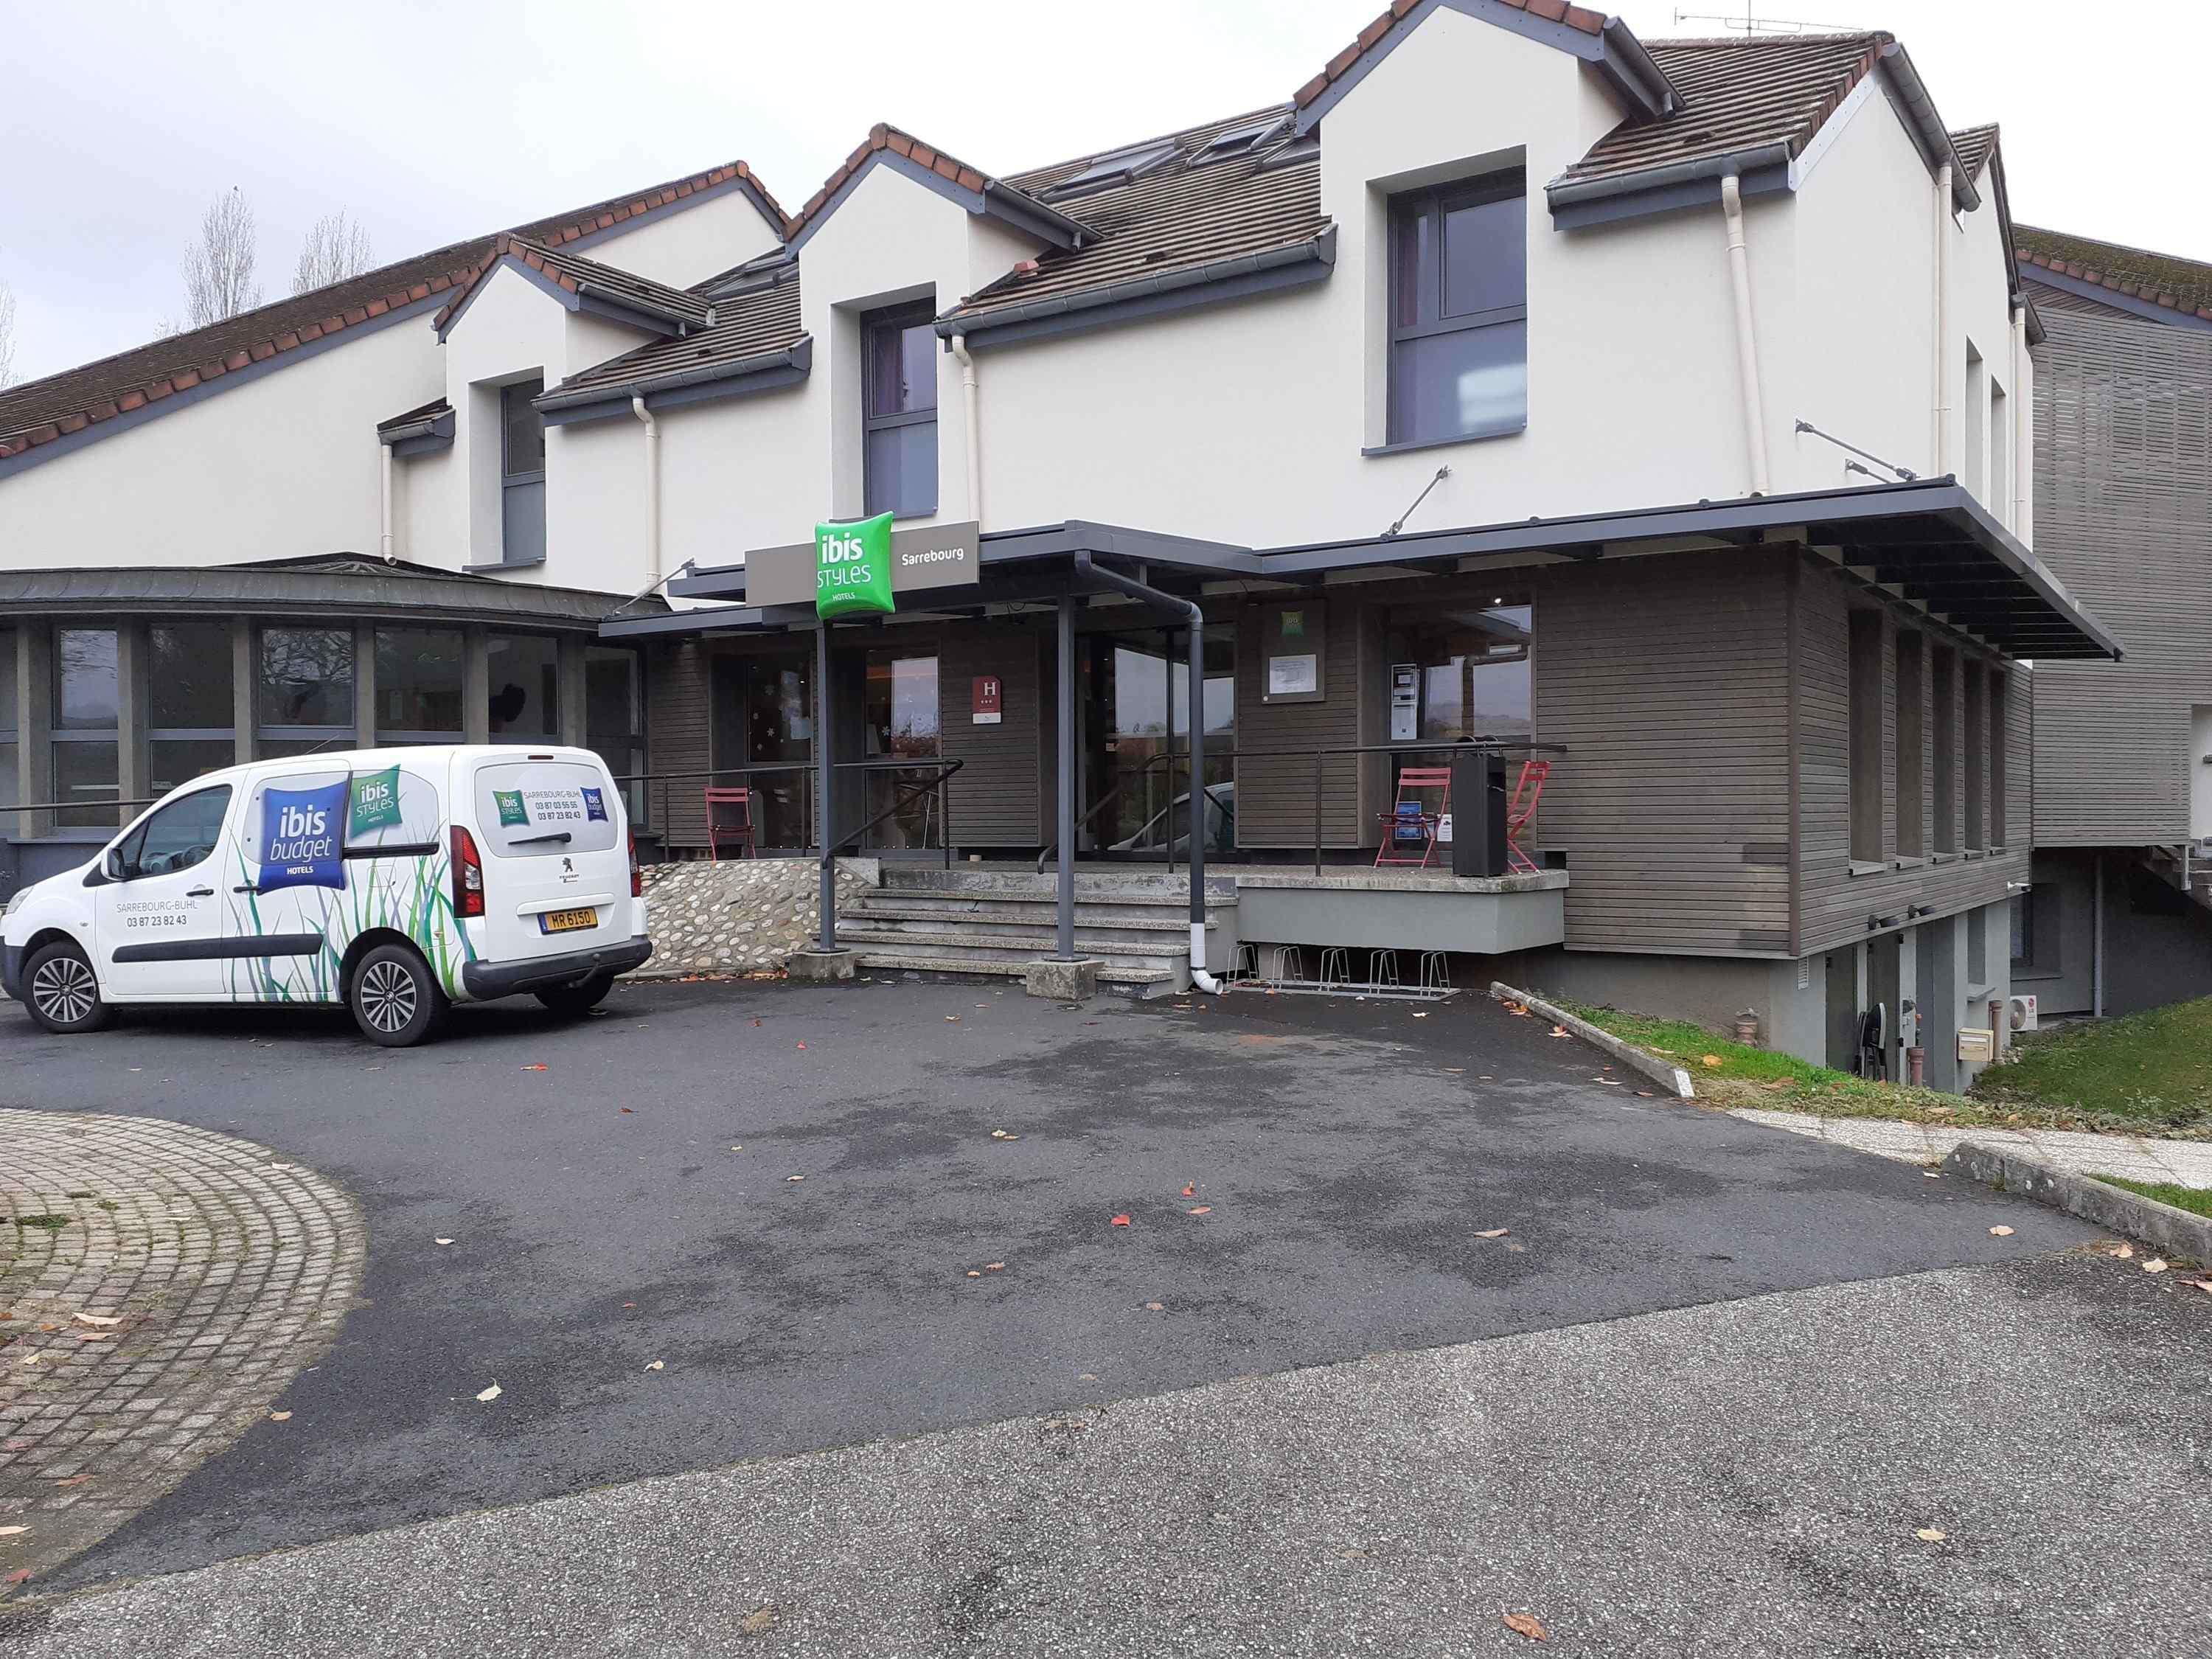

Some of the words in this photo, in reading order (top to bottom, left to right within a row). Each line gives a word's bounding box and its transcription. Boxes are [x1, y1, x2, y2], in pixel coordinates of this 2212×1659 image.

[822, 532, 863, 564] ibis
[902, 548, 964, 566] Sarrebourg
[832, 591, 856, 602] HOTELS
[984, 682, 996, 696] H
[361, 782, 389, 803] ibis
[501, 796, 519, 807] ibis
[535, 801, 544, 810] 03
[553, 801, 561, 810] 03
[280, 804, 326, 838] ibis
[538, 812, 546, 820] 03
[548, 812, 555, 820] 87
[556, 812, 565, 820] 23
[565, 811, 573, 819] 82
[270, 835, 333, 863] budget
[287, 866, 313, 875] HOTELS
[116, 899, 199, 913] SARREBOURG-BUHL
[127, 917, 137, 928] 03
[139, 917, 149, 927] 87
[151, 916, 162, 926] 23
[163, 915, 175, 925] 82
[176, 914, 187, 925] 43
[567, 911, 591, 926] 6150
